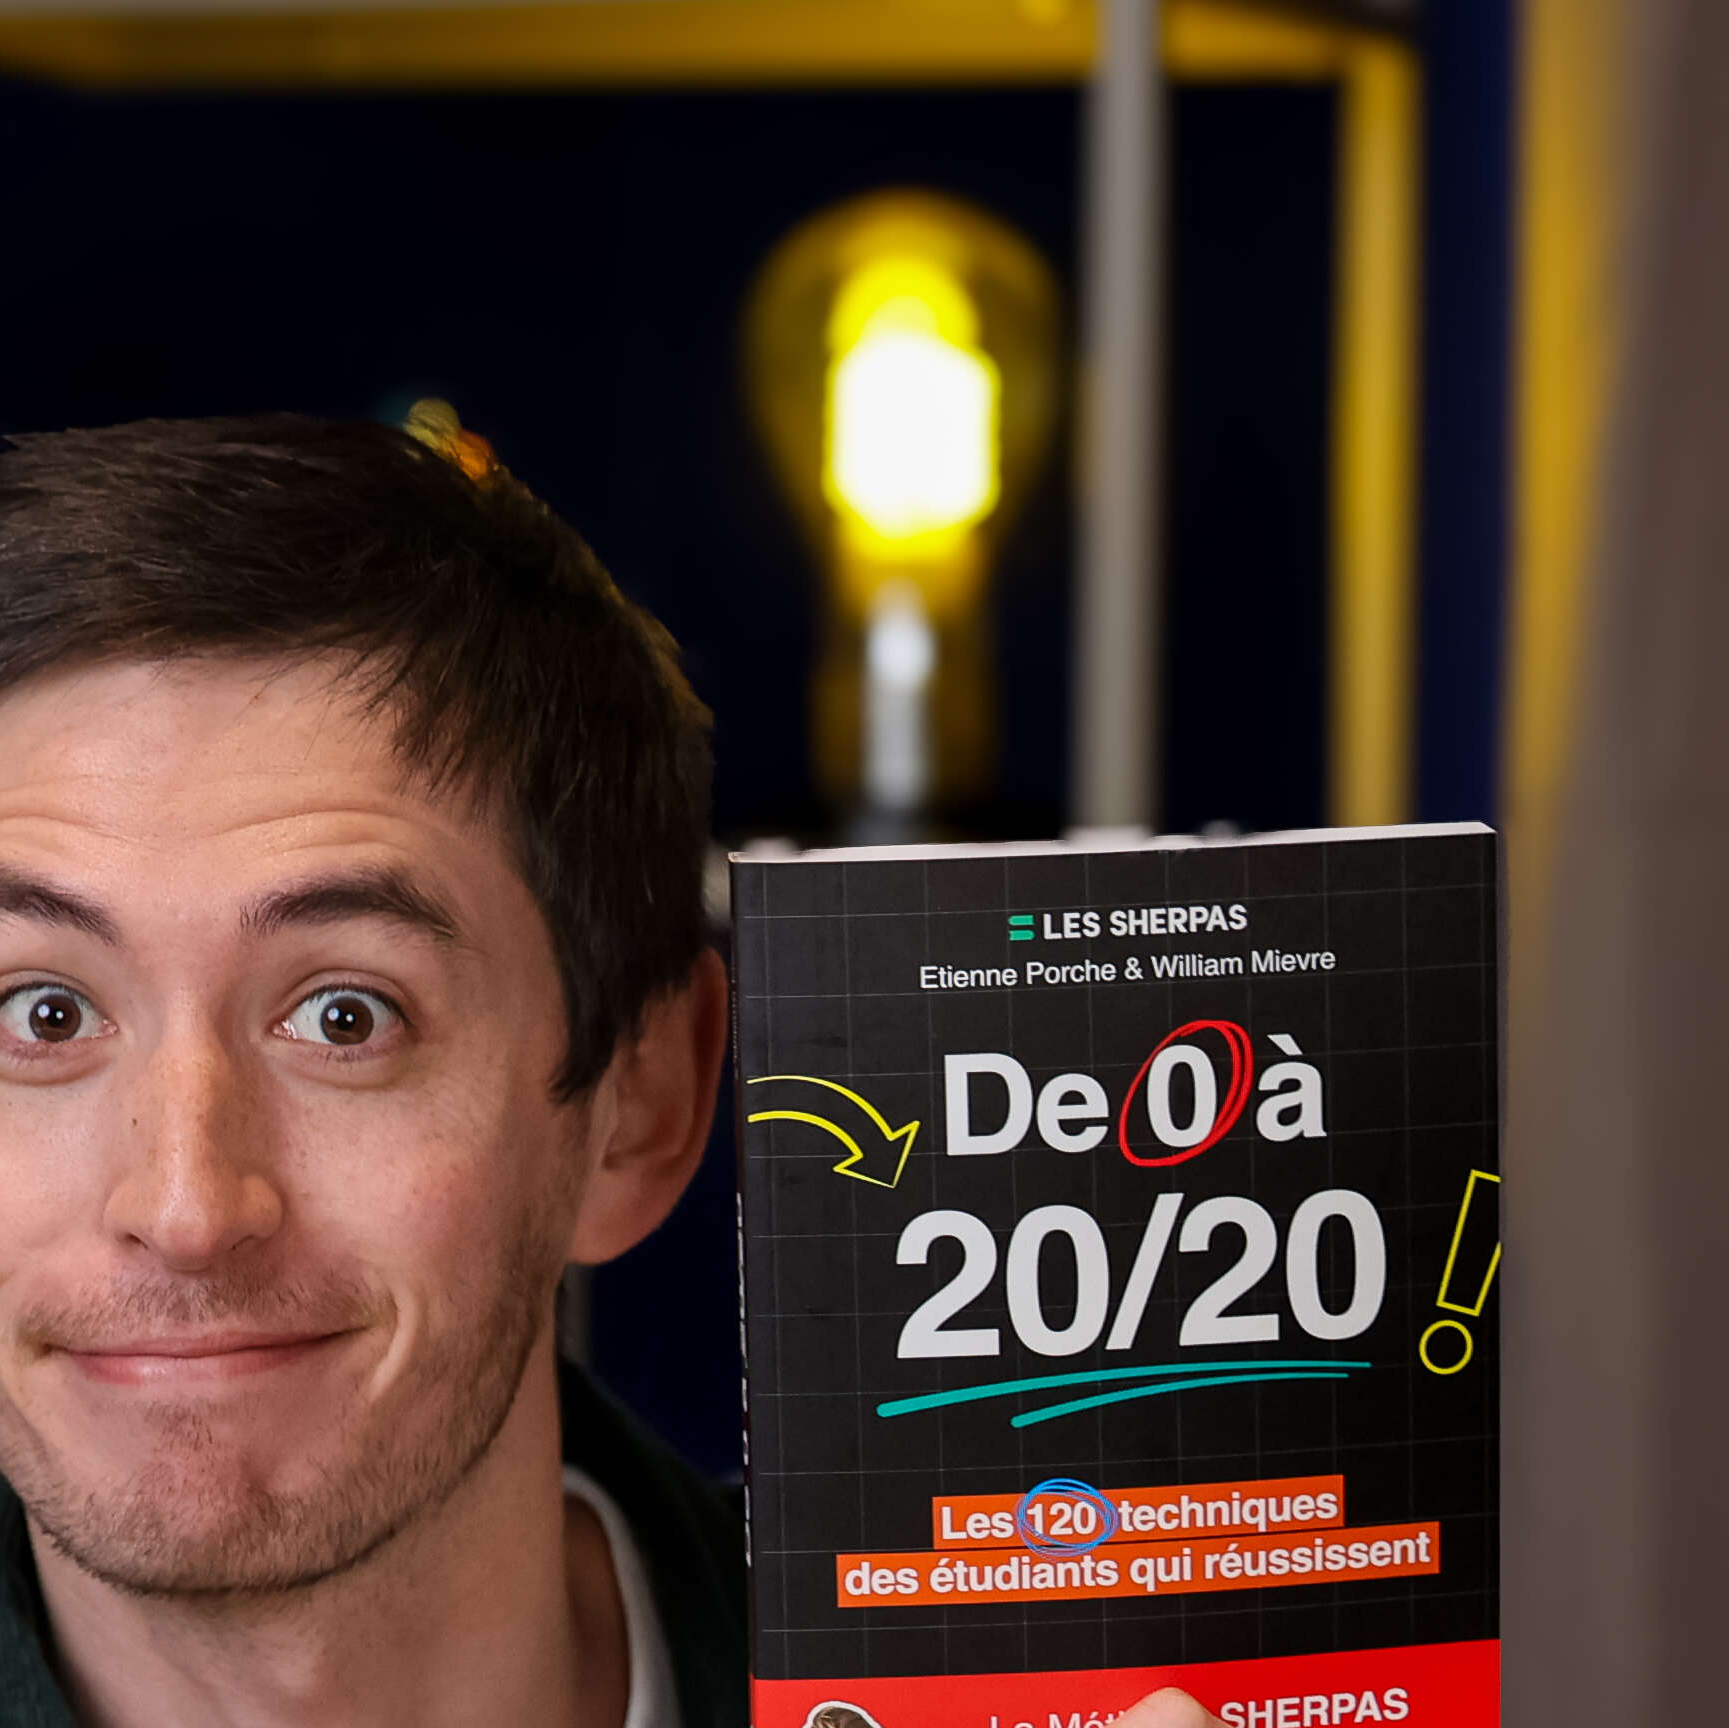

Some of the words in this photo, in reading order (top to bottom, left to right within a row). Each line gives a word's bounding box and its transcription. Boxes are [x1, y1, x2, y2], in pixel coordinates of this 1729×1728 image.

[1043, 911, 1101, 941] LES
[1109, 905, 1248, 938] SHERPAS
[919, 961, 1018, 990] Etienne
[1025, 957, 1117, 987] Porche
[1124, 958, 1143, 982] &
[1151, 951, 1243, 979] William
[1252, 946, 1336, 974] Mievre
[944, 1051, 1110, 1158] De
[1146, 1044, 1219, 1150] 0
[1255, 1034, 1328, 1143] à
[895, 1189, 1388, 1361] 20/20
[942, 1504, 1016, 1541] Les
[1027, 1501, 1098, 1537] 120
[1117, 1490, 1338, 1534] techniques
[844, 1562, 918, 1597] des
[930, 1551, 1120, 1594] étudiants
[1129, 1547, 1194, 1593] qui
[1204, 1531, 1432, 1581] réussissent
